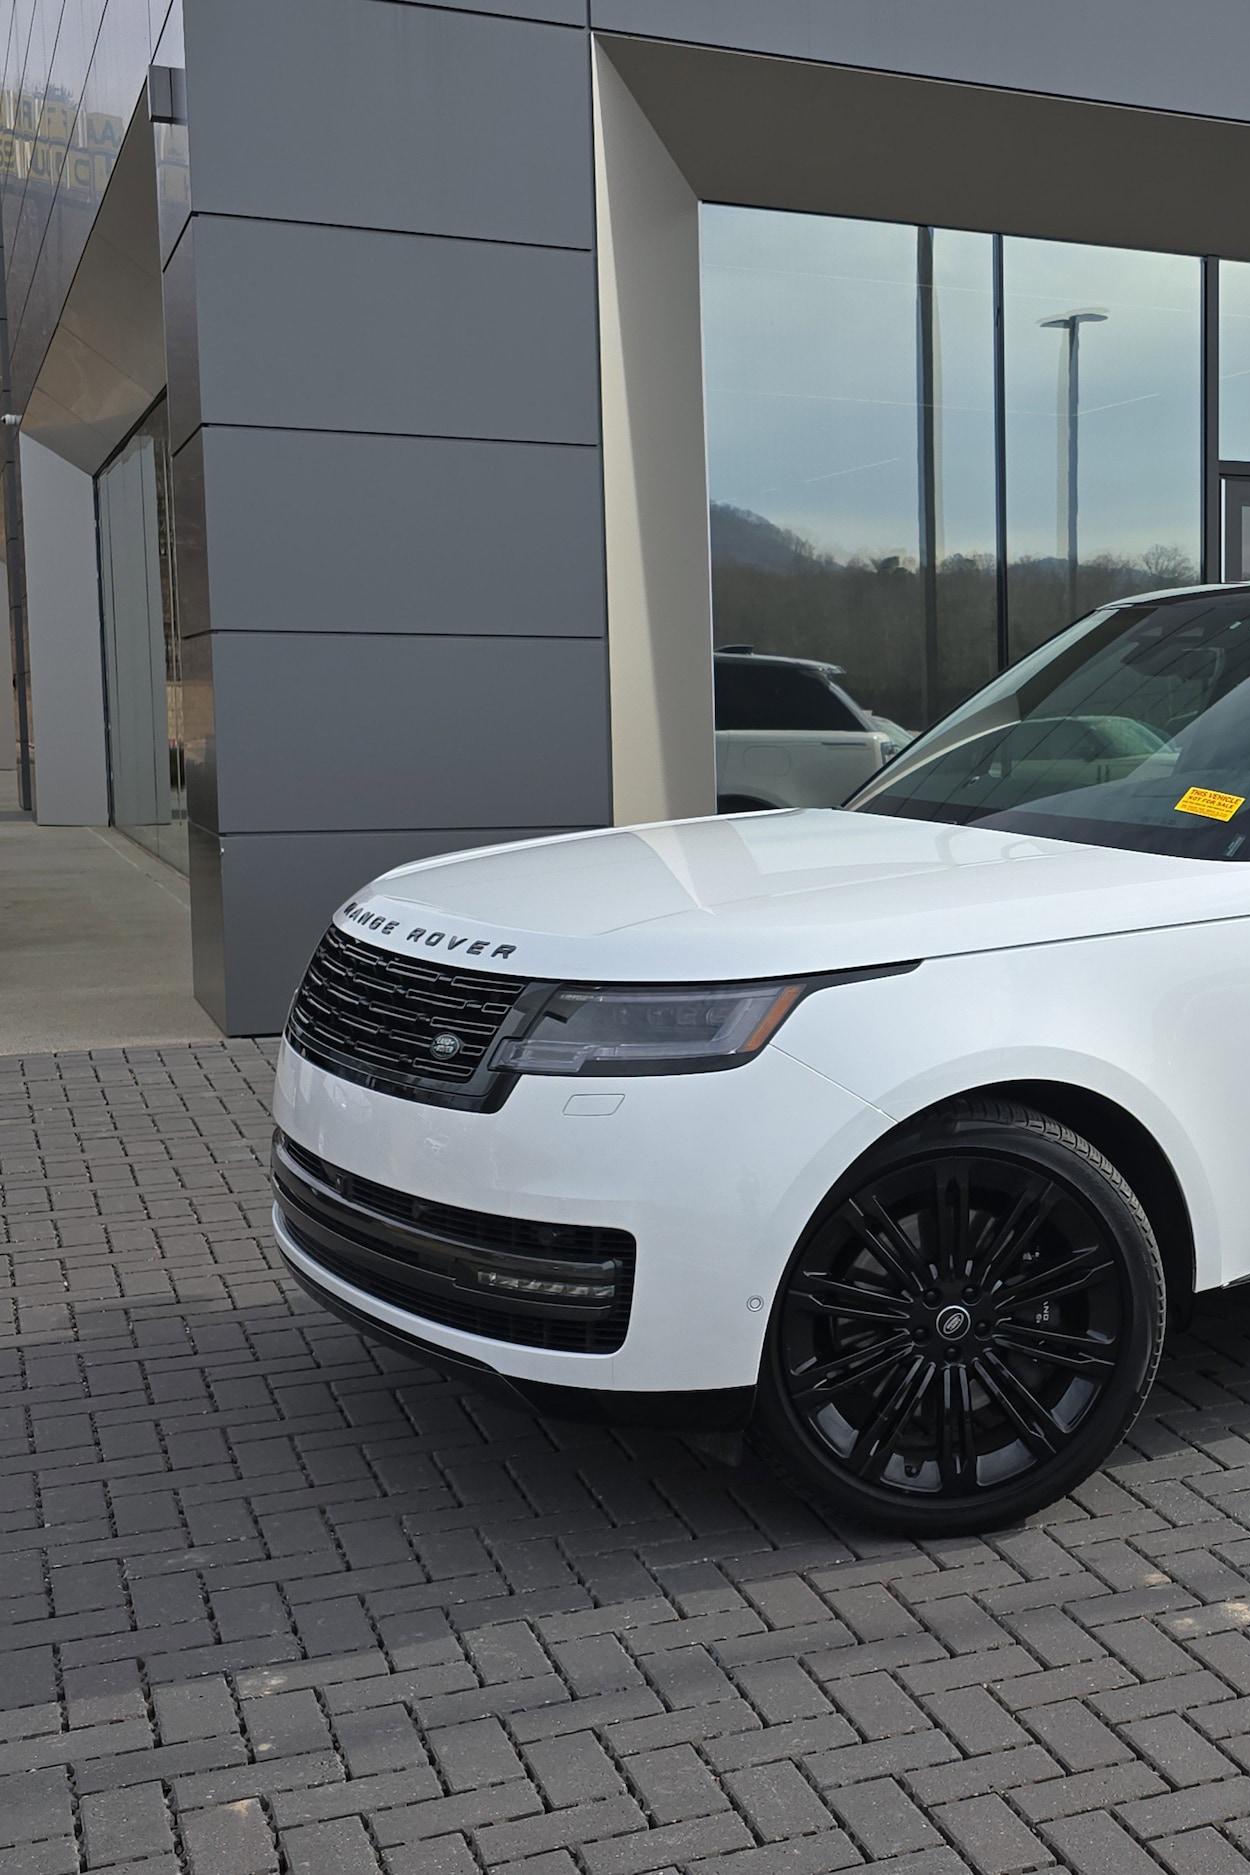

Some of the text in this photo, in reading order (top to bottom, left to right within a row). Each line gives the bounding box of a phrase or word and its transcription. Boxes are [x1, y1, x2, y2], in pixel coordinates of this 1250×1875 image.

[1191, 789, 1241, 804] THIS VEHICLE
[1217, 801, 1234, 809] SALE
[343, 902, 517, 959] RANGE ROVER
